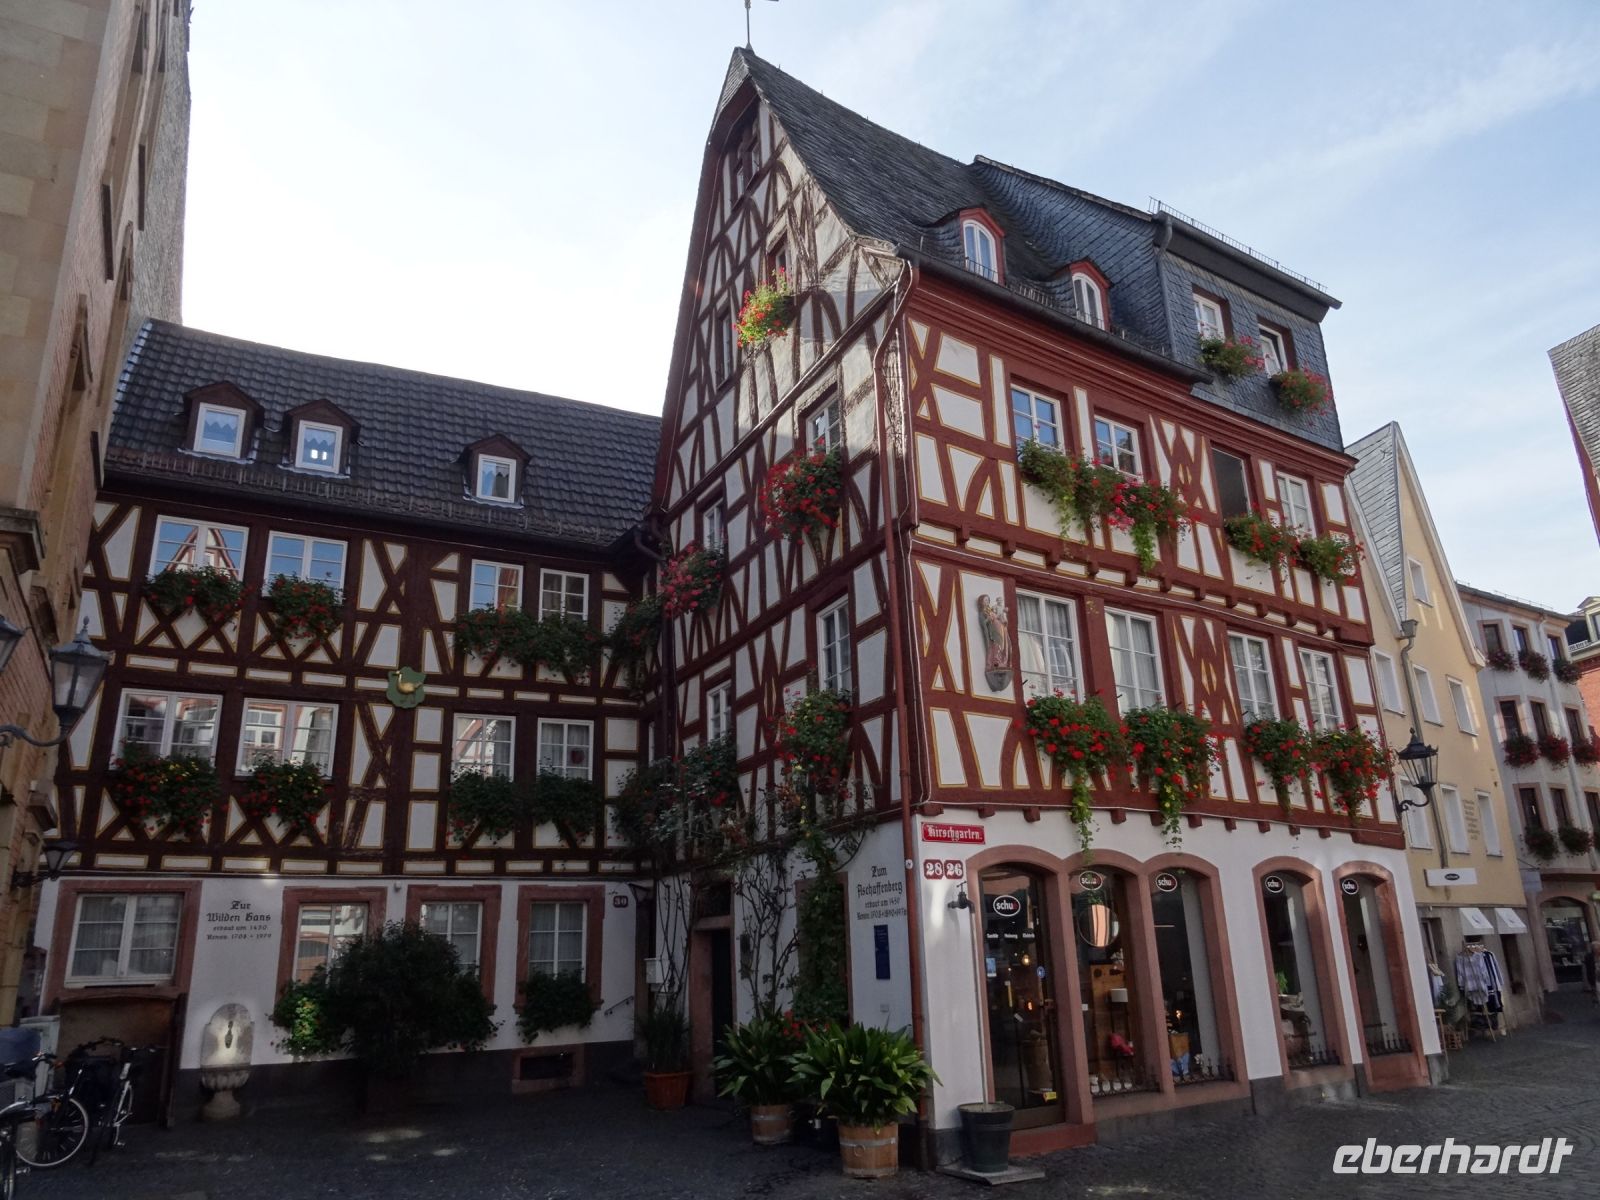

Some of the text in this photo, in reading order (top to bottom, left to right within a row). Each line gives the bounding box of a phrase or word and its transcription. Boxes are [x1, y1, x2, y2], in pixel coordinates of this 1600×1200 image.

[871, 865, 887, 877] Zum
[926, 862, 963, 876] 28 26
[230, 900, 251, 910] Zur
[207, 912, 271, 922] Wilden Gans
